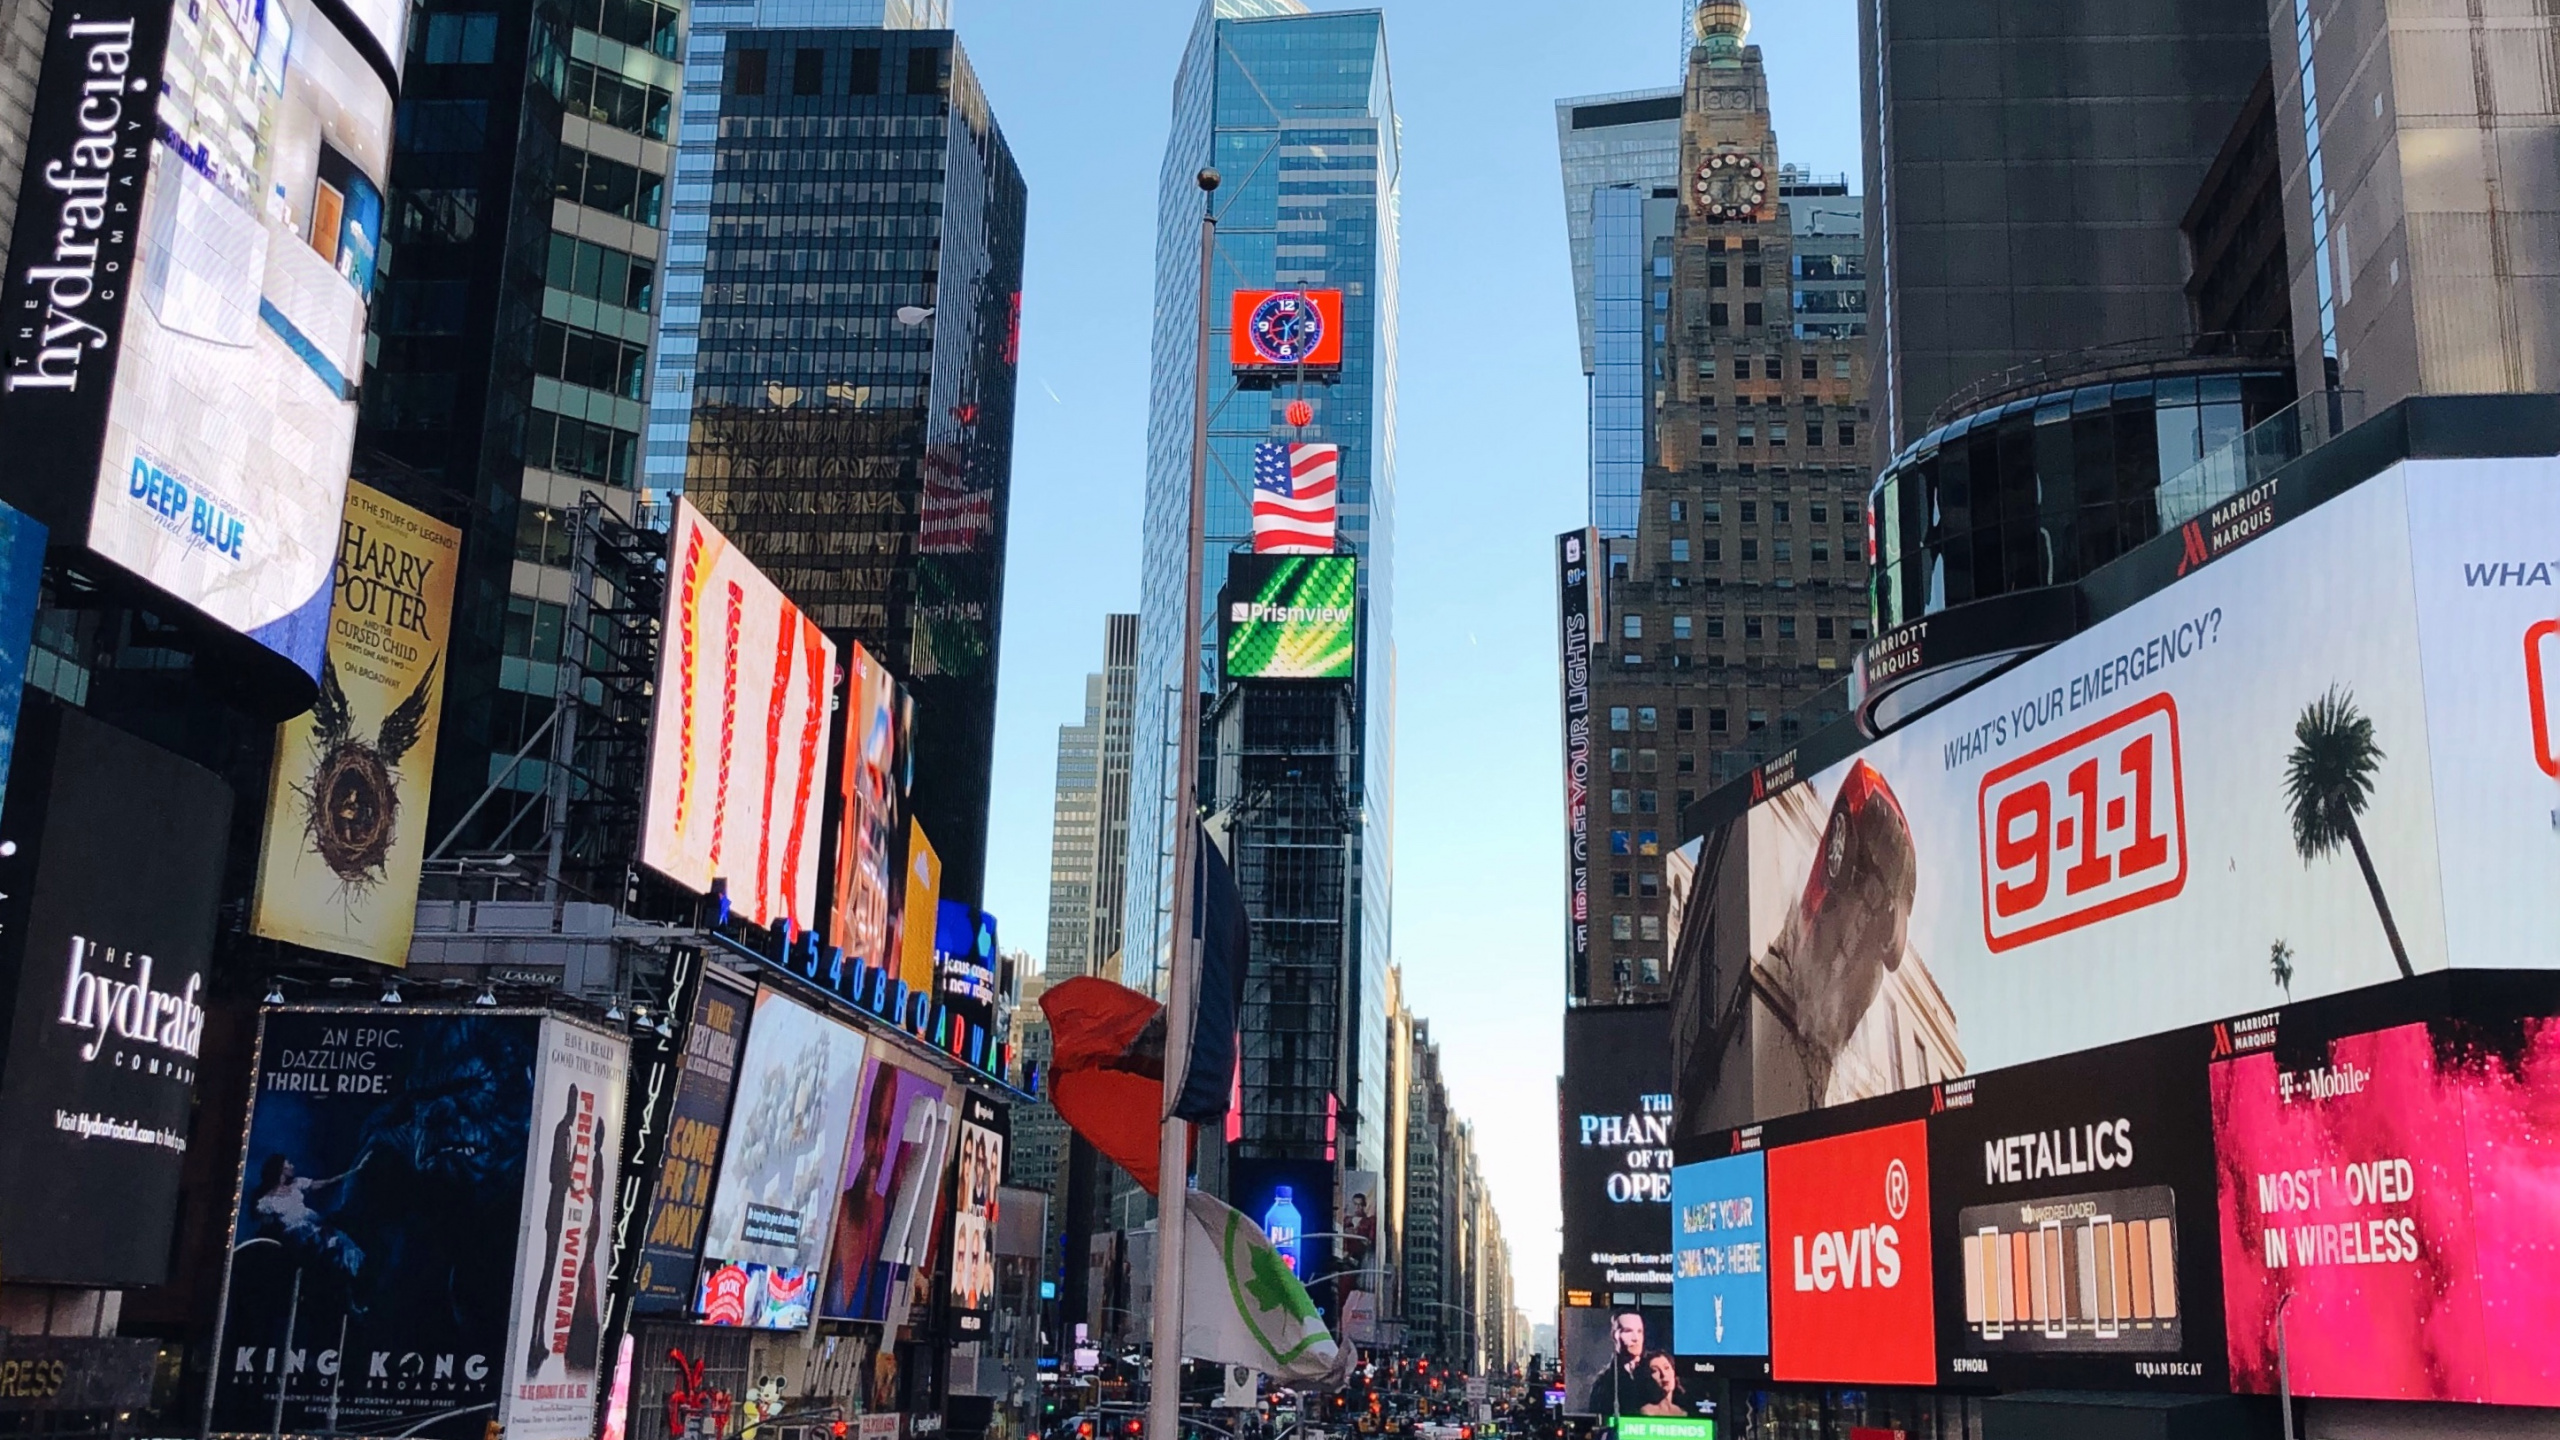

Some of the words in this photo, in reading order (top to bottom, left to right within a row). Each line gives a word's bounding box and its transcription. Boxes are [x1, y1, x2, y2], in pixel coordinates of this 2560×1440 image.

[7, 17, 146, 392] hydrafacial
[102, 119, 141, 301] COMPANY
[1280, 300, 1295, 311] 12
[15, 299, 38, 366] THE
[1259, 321, 1269, 332] 9
[1304, 321, 1315, 332] 3
[1280, 345, 1291, 355] 6
[129, 456, 187, 520] DEEP
[192, 495, 244, 561] BLUE
[351, 495, 359, 507] IS
[361, 500, 378, 516] THE
[380, 508, 404, 528] STUFF
[407, 520, 419, 533] OF
[2212, 478, 2278, 528] MARRIOTT
[153, 514, 189, 537] med
[181, 534, 208, 562] spa
[2213, 506, 2272, 551] MARQUIS
[340, 520, 434, 597] HARRY
[2464, 562, 2560, 587] WHA
[332, 562, 431, 641] POTTER
[1251, 602, 1348, 622] Prismview
[336, 618, 380, 648] CURSED
[383, 637, 417, 663] CHILD
[1868, 622, 1928, 662] MARRIOTT
[344, 661, 357, 674] ON
[359, 665, 401, 690] BROADWAY
[1567, 612, 1588, 714] LIGHTS
[1869, 648, 1919, 684] MARQUIS
[1944, 715, 2007, 772] WHAT'S
[2011, 687, 2064, 739] YOUR
[2069, 607, 2223, 713] EMERGENCY?
[1569, 714, 1589, 803] YOUR
[1765, 748, 1797, 776] MARRIOTT
[1766, 767, 1794, 792] MARQUIS
[88, 941, 133, 968] THE
[505, 971, 556, 983] LAMAR
[783, 918, 865, 1002] 1540
[873, 968, 1012, 1081] BROADWAY
[2234, 1012, 2280, 1034] MARRIOTT
[2235, 1030, 2277, 1050] MARQUIS
[282, 1050, 376, 1070] DAZZLING
[552, 1049, 573, 1069] GOOD
[576, 1056, 592, 1074] TIME
[564, 1032, 582, 1051] HAVE
[590, 1041, 614, 1061] REALLY
[267, 1072, 330, 1092] THRILL
[1945, 1079, 1976, 1095] MARRIOTT
[1946, 1093, 1973, 1108] MARQUIS
[56, 1109, 77, 1131] Visit
[78, 1112, 155, 1145] HydraFacial.com
[671, 1116, 720, 1166] COME
[570, 1090, 595, 1205] PRETTY
[1627, 1150, 1653, 1169] OF
[1985, 1118, 2133, 1185] METALLICS
[2258, 1168, 2322, 1214] MOST
[2331, 1158, 2414, 1207] LOVED
[650, 1203, 703, 1249] AWAY
[1719, 1197, 1753, 1230] YOUR
[1600, 1253, 1631, 1265] Majestic
[1632, 1253, 1660, 1264] Theatre
[1727, 1242, 1762, 1274] HERE
[2264, 1227, 2288, 1268] IN
[2293, 1217, 2418, 1267] WIRELESS
[552, 1226, 581, 1354] WOMAN
[0, 1360, 67, 1397] RESS
[234, 1346, 341, 1375] KING
[369, 1351, 489, 1381] KONG
[1953, 1358, 1988, 1373] SEPHORA
[2135, 1362, 2168, 1378] URBAN
[2170, 1362, 2202, 1376] DECAY
[366, 1380, 487, 1392] BROADWAY
[1650, 1425, 1706, 1438] FRIENDS
